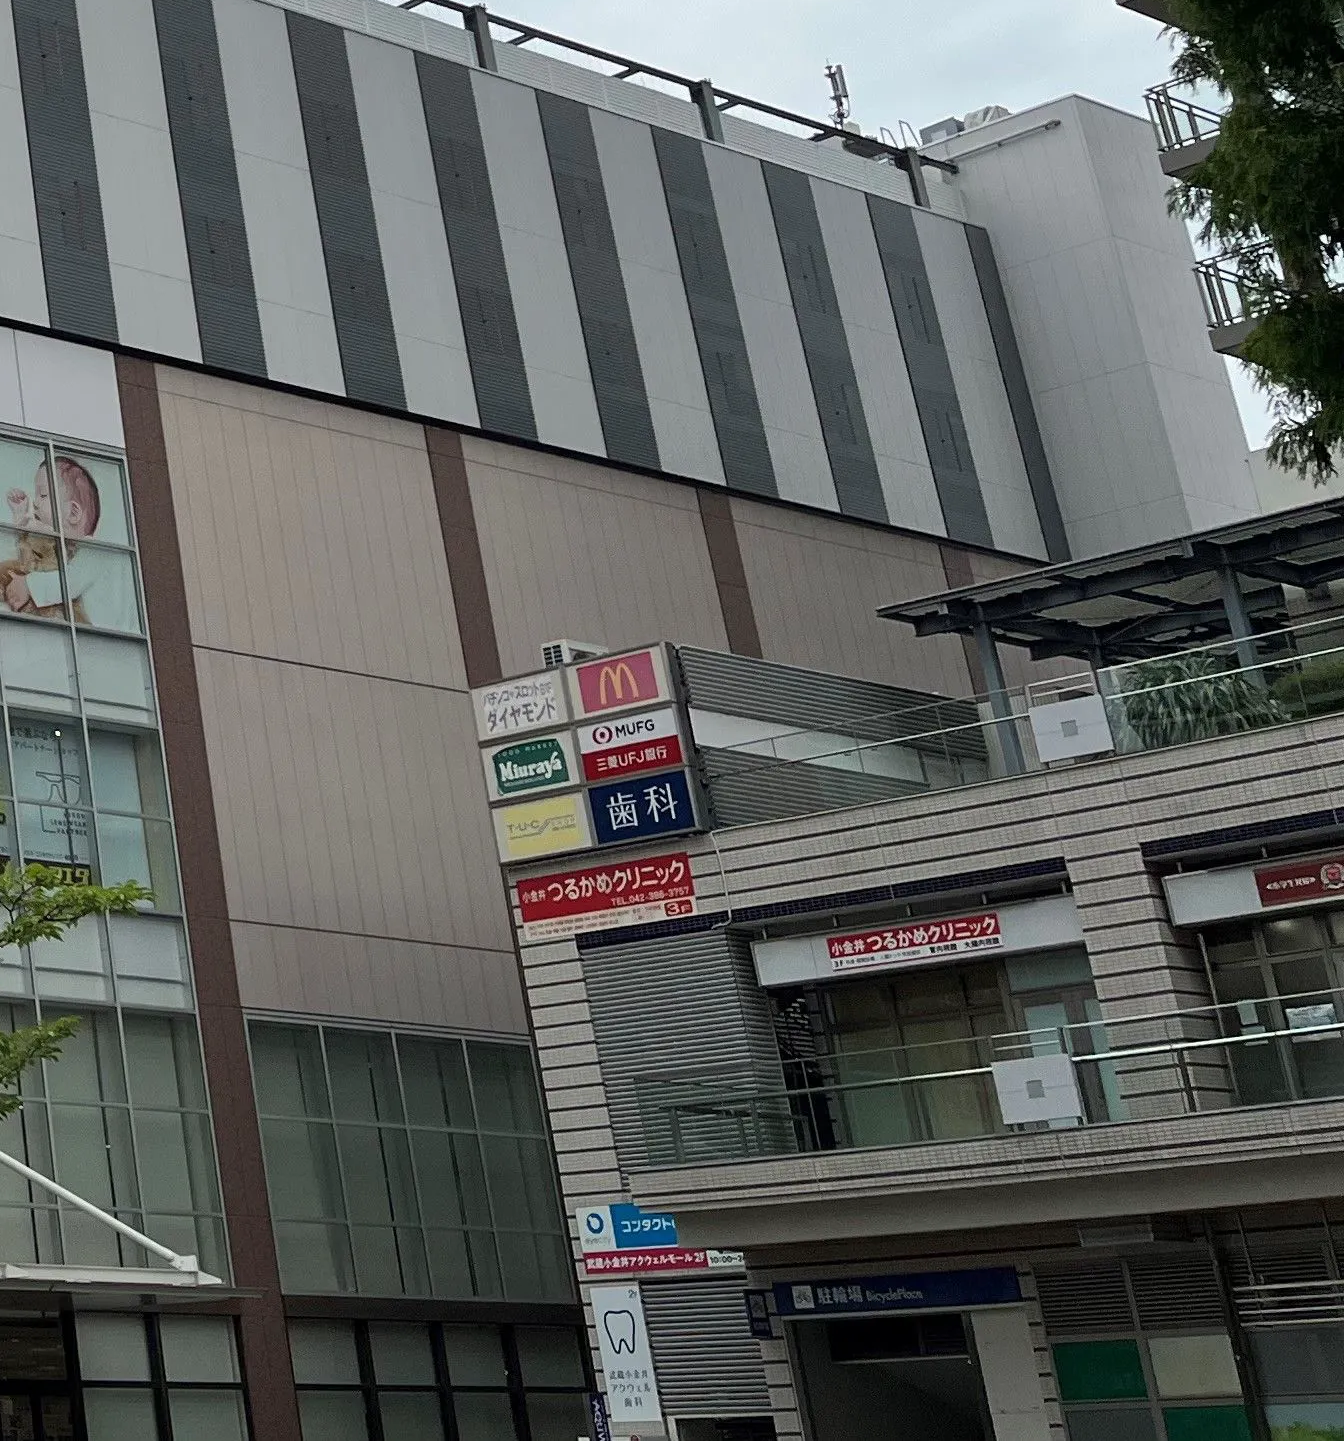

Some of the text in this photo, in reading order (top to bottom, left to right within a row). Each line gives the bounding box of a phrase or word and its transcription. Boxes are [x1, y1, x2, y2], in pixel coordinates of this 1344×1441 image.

[486, 696, 556, 732] ダイヤモンド
[615, 718, 656, 739] MUFG
[498, 751, 563, 782] Miuraya
[596, 745, 668, 772] 三菱UFJ銀行
[606, 783, 679, 831] 歯科
[816, 1284, 863, 1306] 駐輪場
[623, 1396, 643, 1408] 歯科
